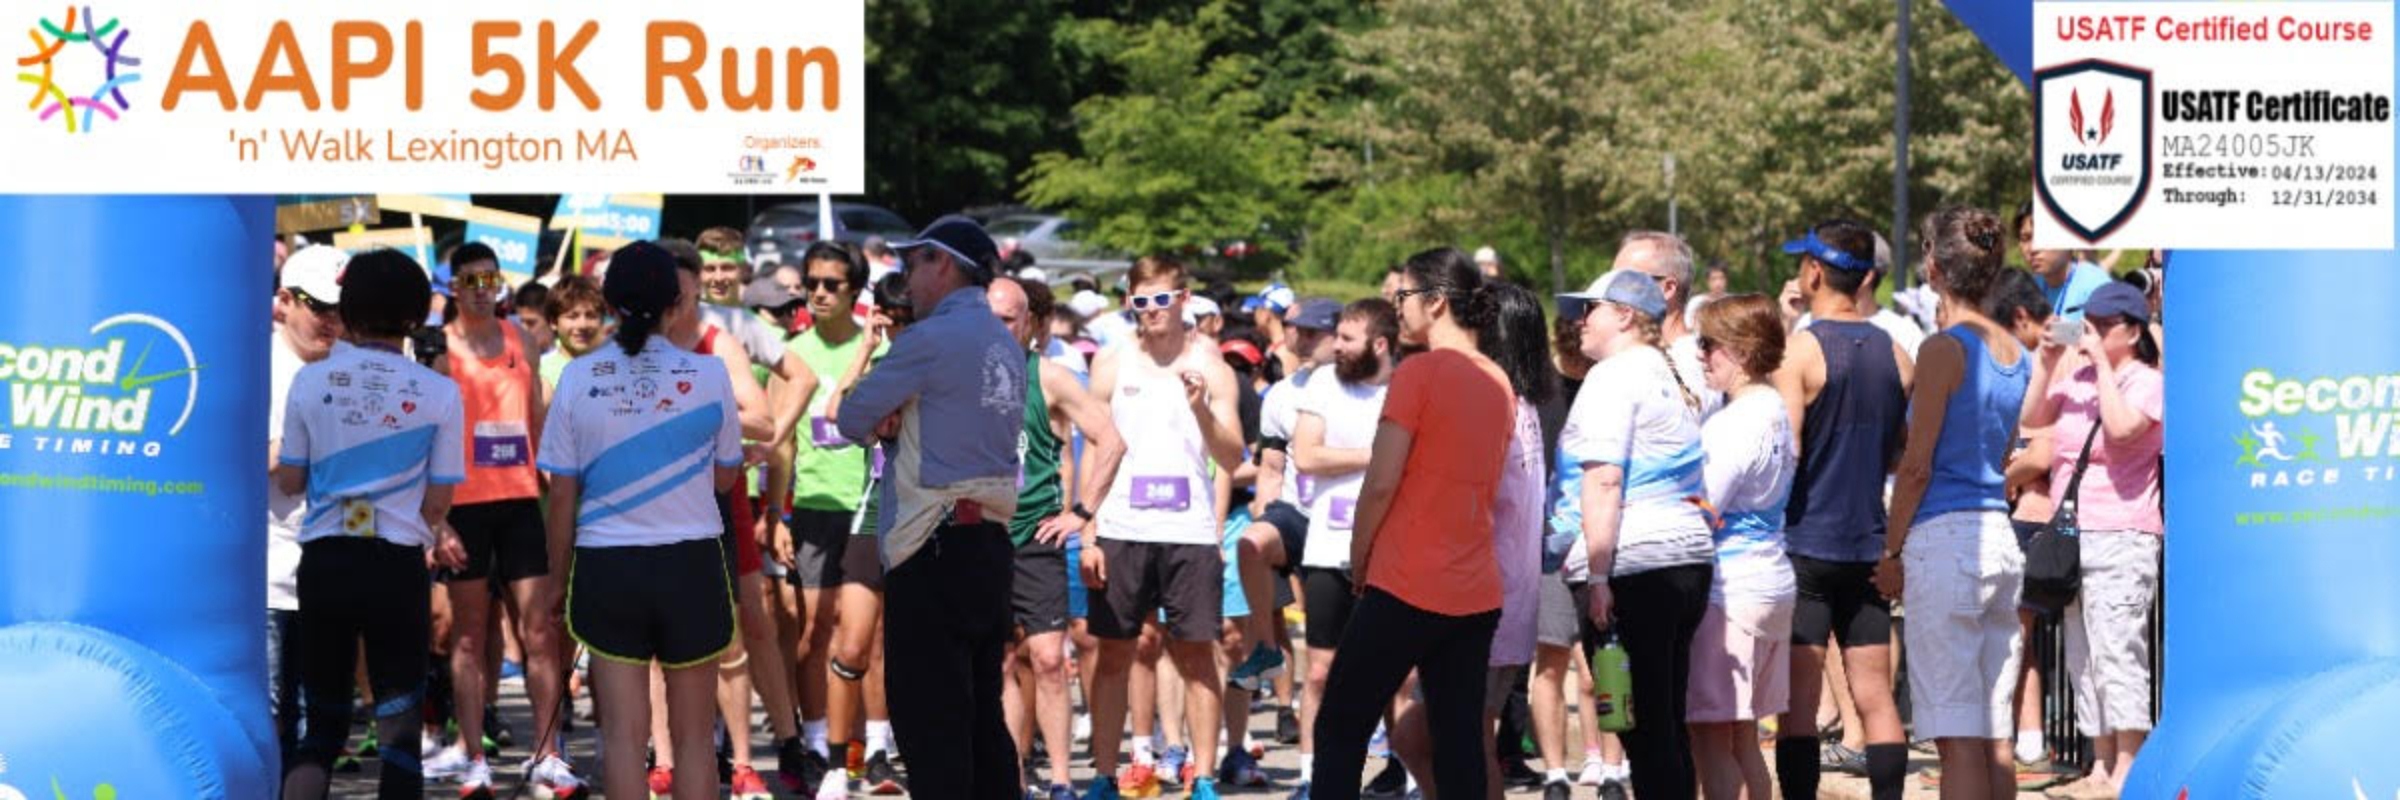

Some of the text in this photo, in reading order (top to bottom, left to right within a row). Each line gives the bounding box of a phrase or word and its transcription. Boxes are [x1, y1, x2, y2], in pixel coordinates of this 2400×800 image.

[11, 382, 152, 433] Wind
[34, 436, 161, 457] TIMING
[2251, 467, 2340, 488] RACE
